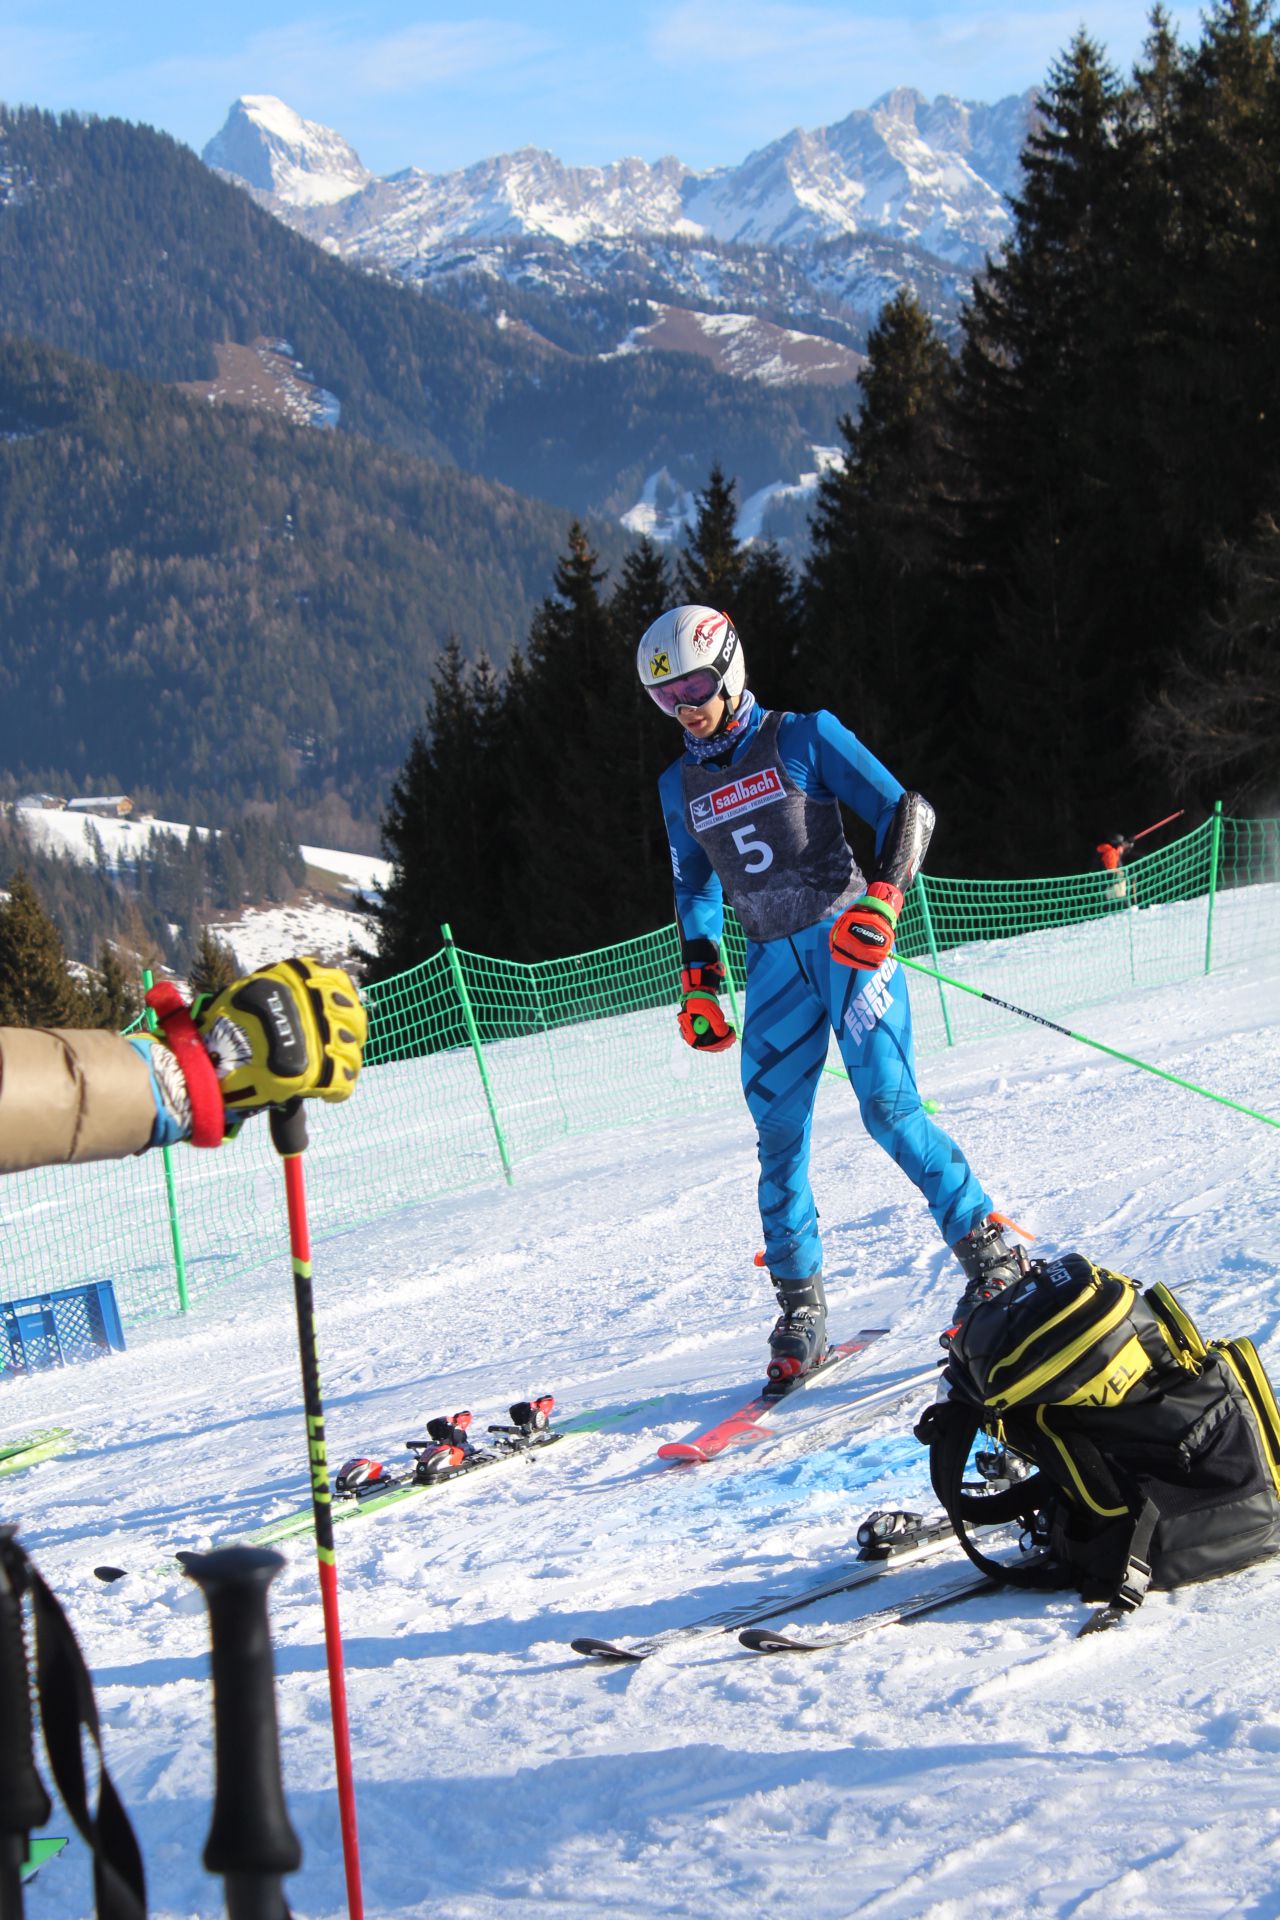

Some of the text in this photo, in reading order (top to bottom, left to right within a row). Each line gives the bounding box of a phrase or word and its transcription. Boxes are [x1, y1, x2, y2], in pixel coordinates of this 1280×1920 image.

[715, 771, 775, 810] saalbach
[731, 823, 774, 874] 5
[267, 991, 296, 1046] LEVEL
[850, 987, 895, 1047] PURA
[307, 1414, 332, 1504] LEKI
